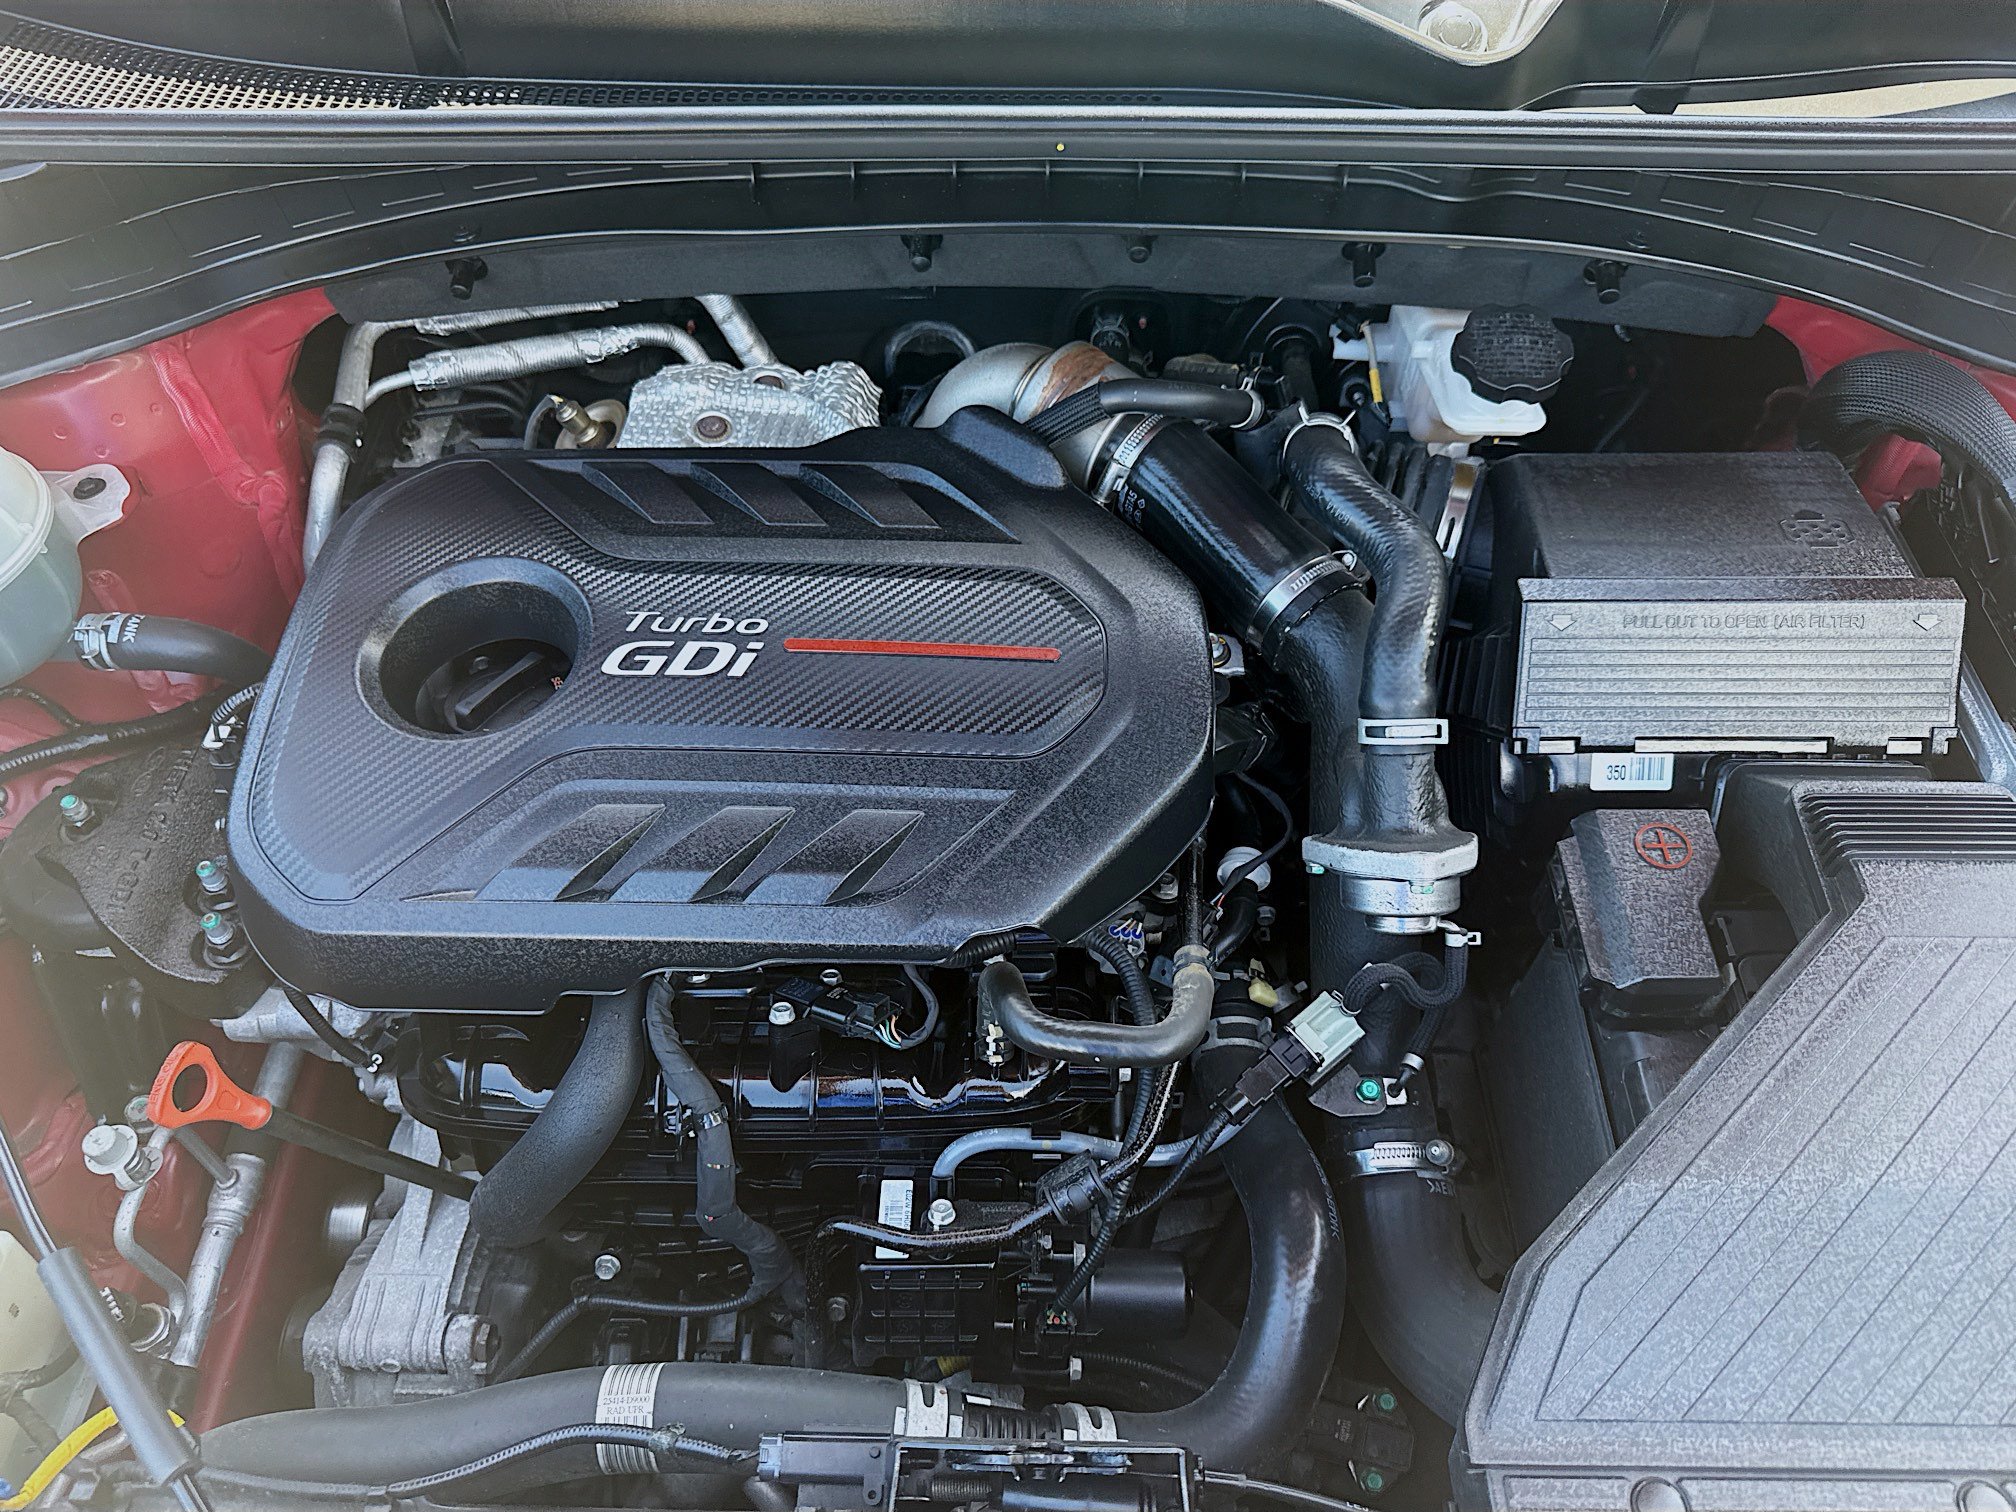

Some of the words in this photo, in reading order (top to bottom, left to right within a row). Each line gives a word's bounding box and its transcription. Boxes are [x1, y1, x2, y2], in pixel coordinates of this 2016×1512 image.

[122, 613, 146, 643] TANK
[626, 610, 770, 635] Turbo
[1622, 614, 1662, 628] PULL
[1665, 614, 1698, 628] OUT
[1701, 614, 1721, 628] TO
[1725, 614, 1767, 628] OPEN
[1809, 614, 1866, 630] FILTER)
[599, 640, 766, 678] GDi
[1606, 764, 1627, 781] 350
[606, 1405, 626, 1415] RAD
